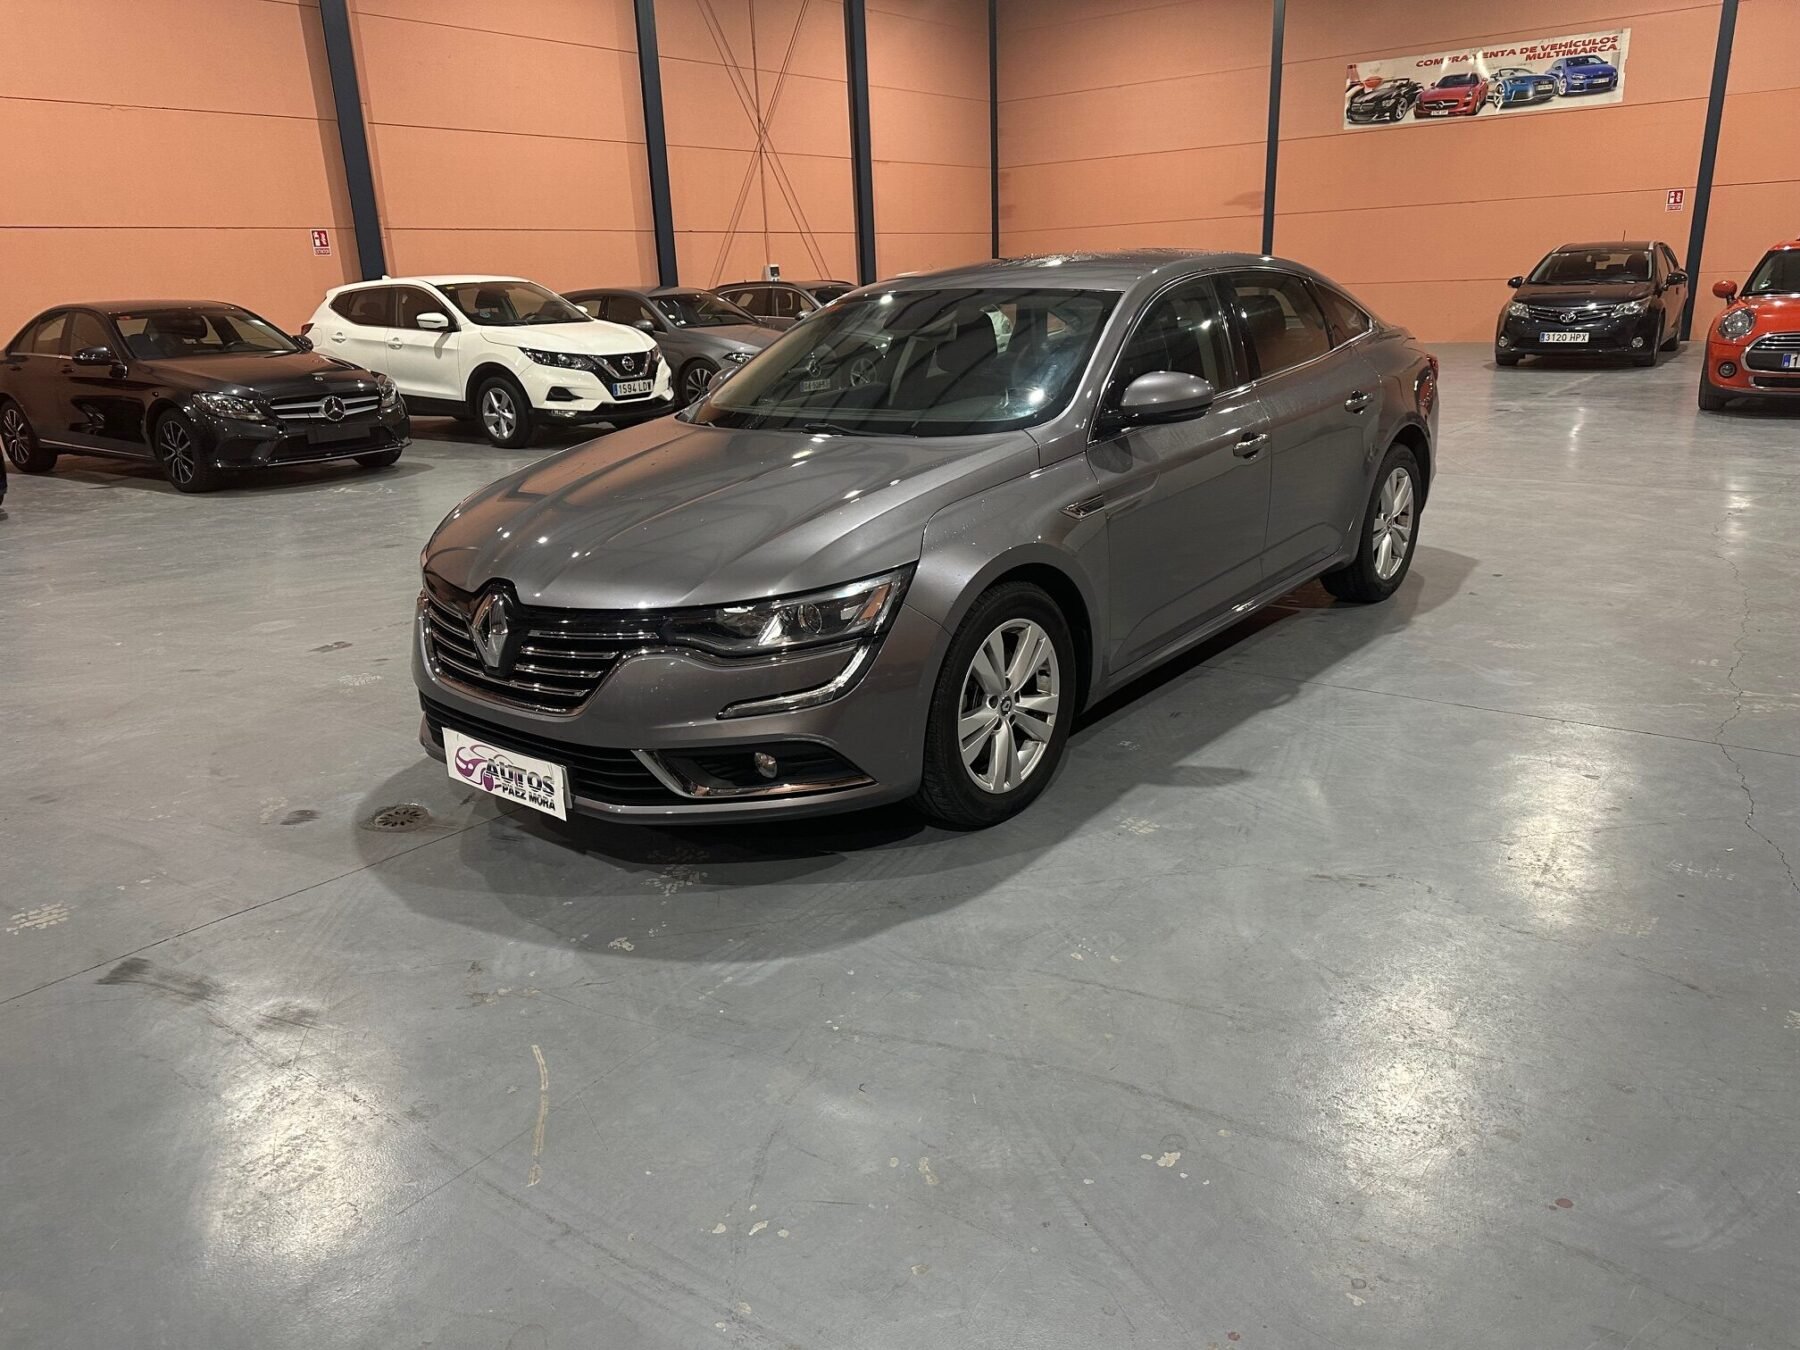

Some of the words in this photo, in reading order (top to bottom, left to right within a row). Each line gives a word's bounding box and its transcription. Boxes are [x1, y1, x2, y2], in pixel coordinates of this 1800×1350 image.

[1520, 46, 1538, 55] DE
[1541, 35, 1618, 52] VEHÍCULOS
[1526, 43, 1617, 61] MULTIMARCA
[1546, 333, 1567, 342] 3120
[1570, 333, 1587, 342] HPX
[619, 382, 637, 395] 1594
[485, 758, 554, 798] AUTOS
[529, 791, 556, 811] MORA
